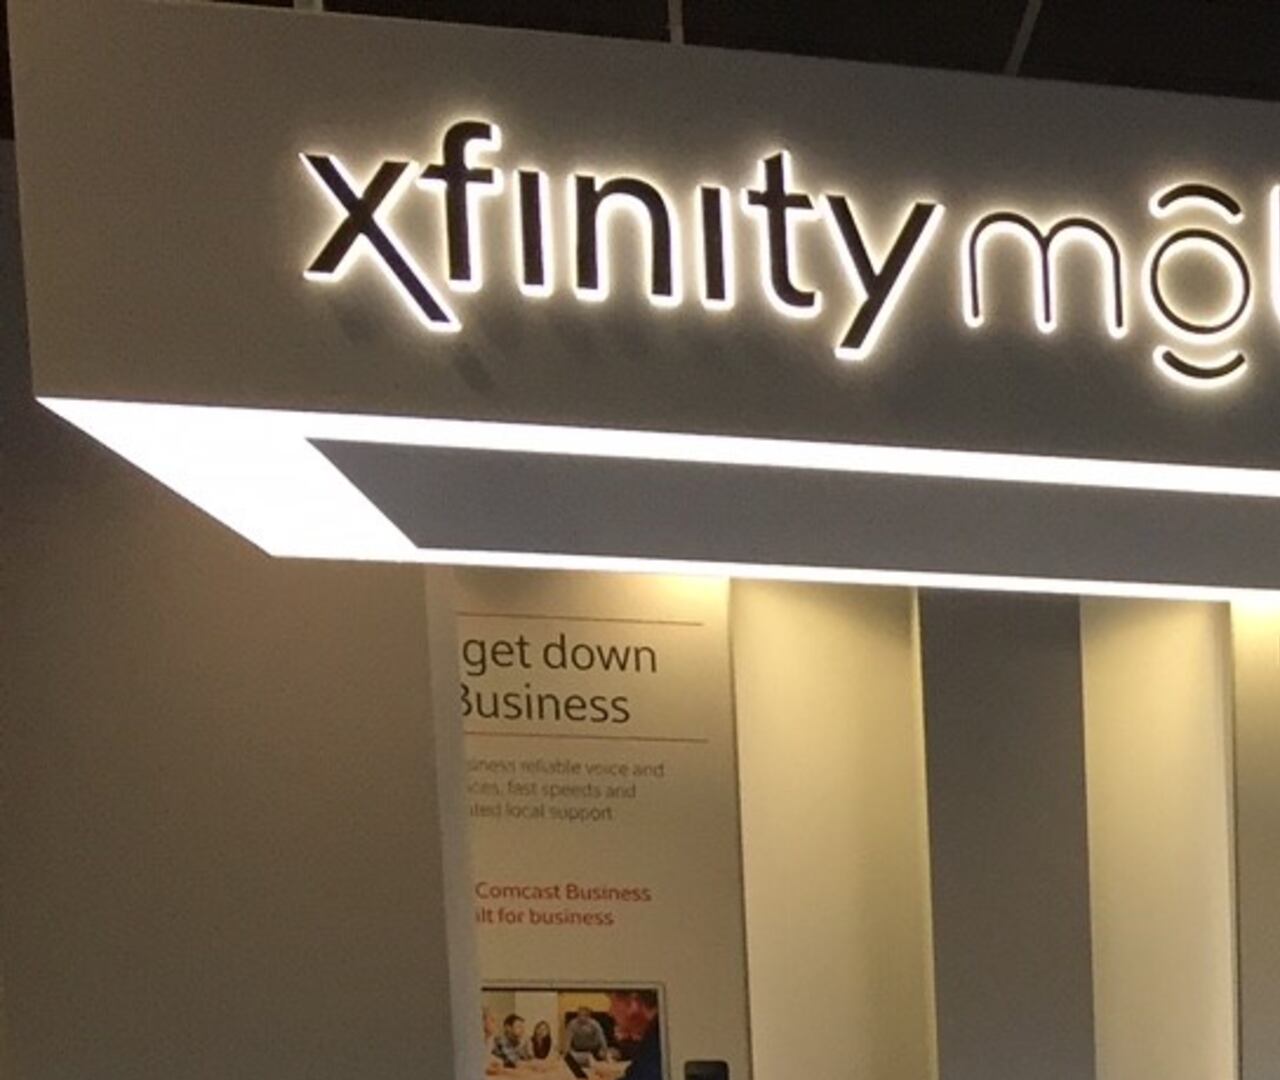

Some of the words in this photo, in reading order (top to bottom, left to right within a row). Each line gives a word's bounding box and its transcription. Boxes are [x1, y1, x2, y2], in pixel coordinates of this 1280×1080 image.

[299, 120, 944, 360] xfinity
[462, 634, 531, 676] get
[543, 633, 657, 673] down
[520, 759, 582, 775] reliable
[585, 761, 629, 777] voice
[632, 763, 665, 778] and
[507, 779, 537, 796] fast
[541, 782, 603, 799] speeds
[606, 784, 637, 799] and
[505, 802, 545, 818] local
[475, 881, 561, 901] Comcast
[565, 883, 652, 902] Business
[498, 907, 525, 924] for
[529, 909, 615, 926] business
